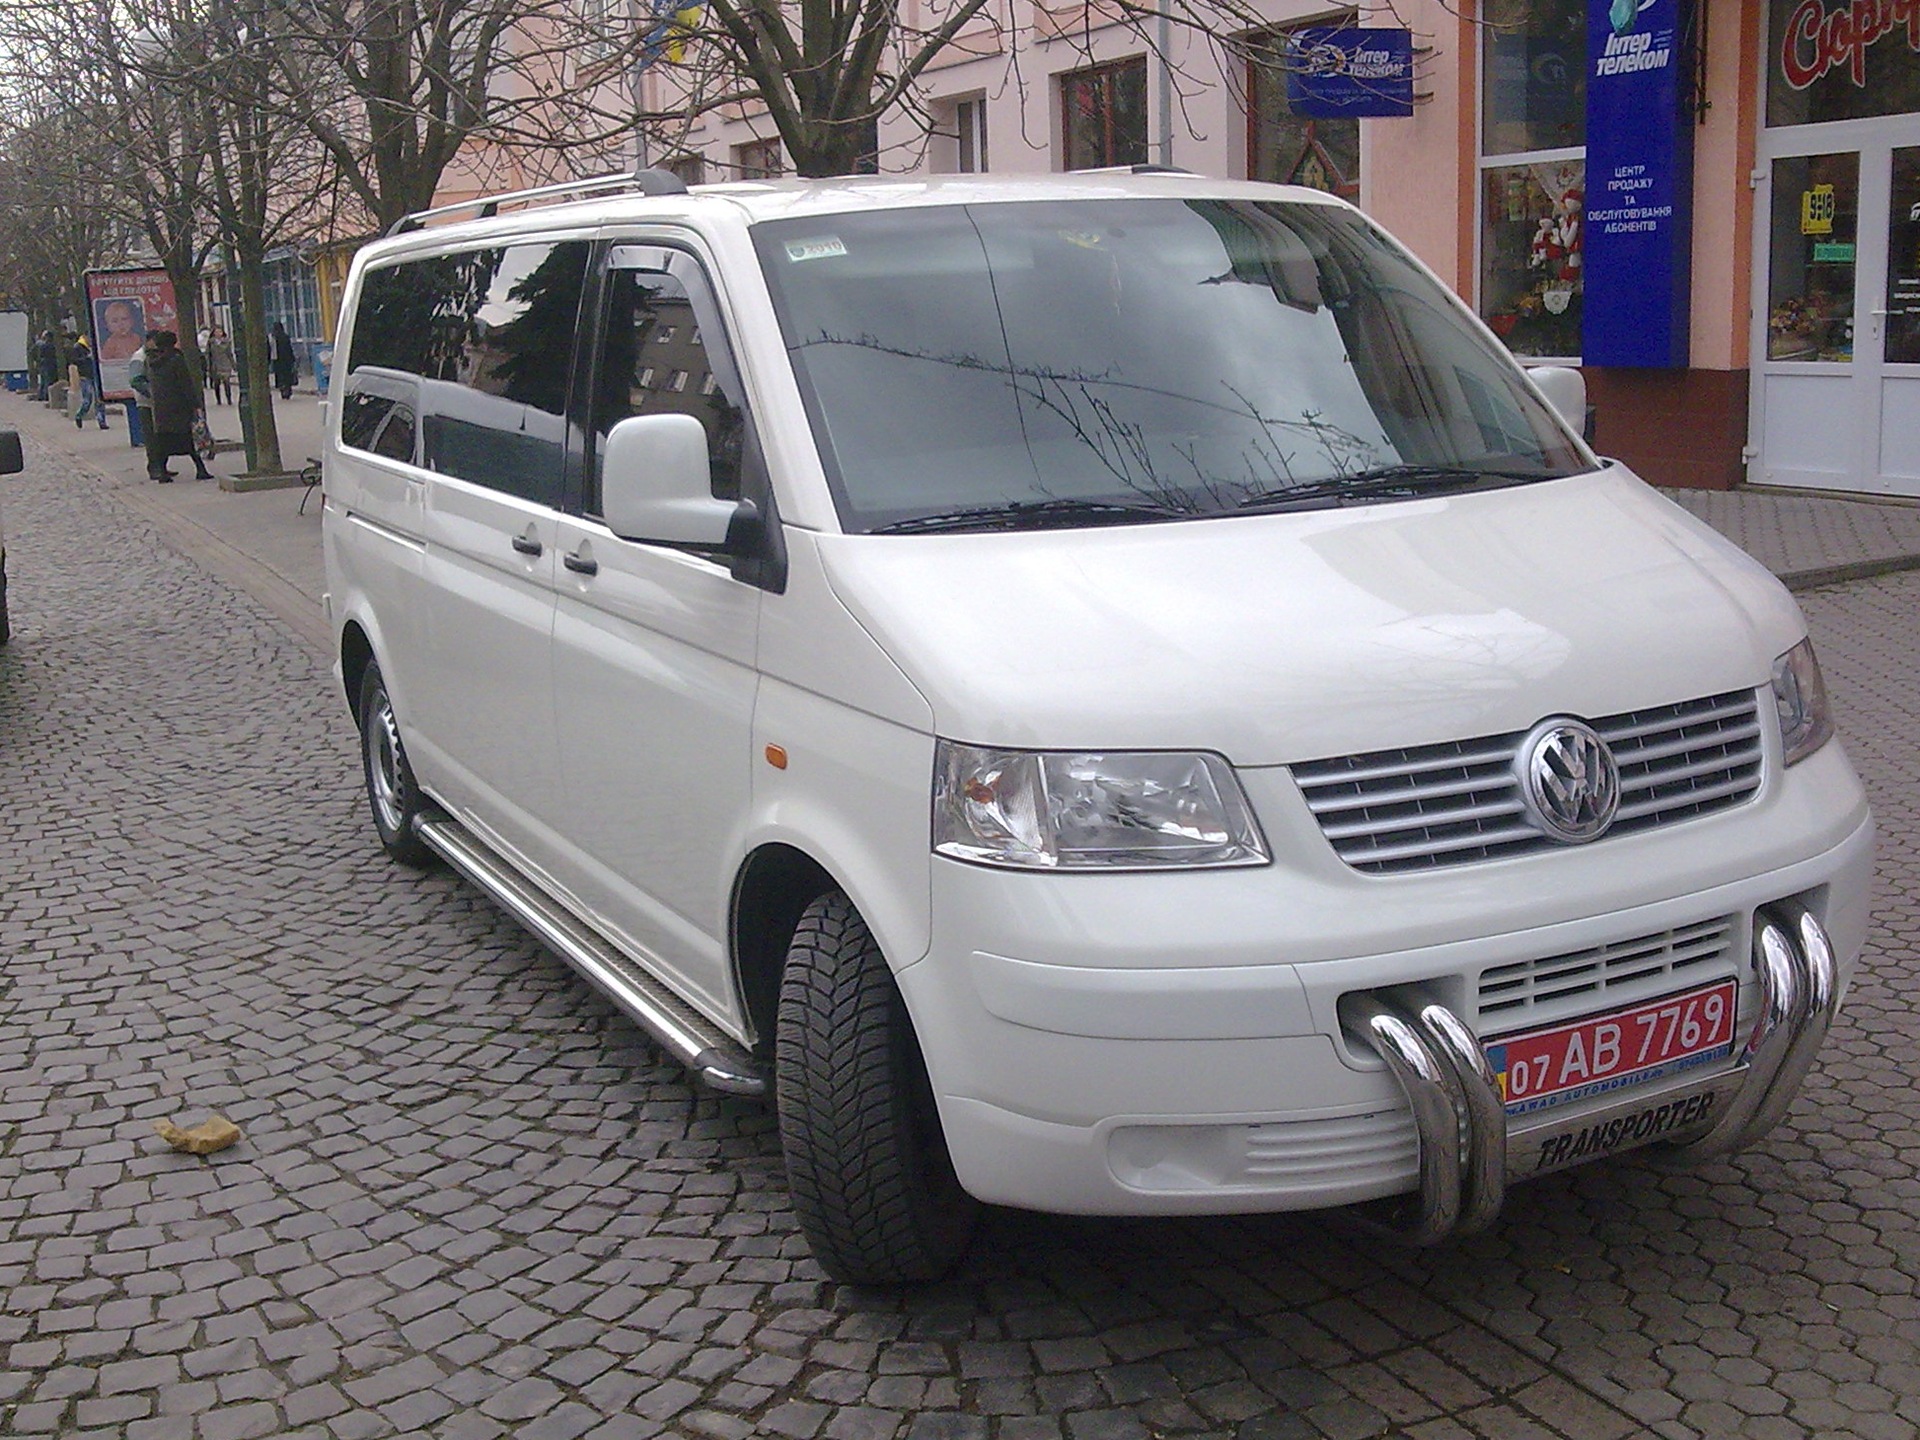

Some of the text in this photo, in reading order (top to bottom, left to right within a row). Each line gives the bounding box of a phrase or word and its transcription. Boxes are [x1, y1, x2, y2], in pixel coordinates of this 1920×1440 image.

[1604, 32, 1651, 57] Інтер
[1596, 49, 1670, 77] телеком
[1614, 165, 1646, 178] ЦЕНТР
[1608, 178, 1653, 191] ПРОДАЖУ
[1624, 195, 1636, 205] ТА
[1588, 206, 1672, 221] ОБСЛУГОВУВАННЯ
[1604, 221, 1657, 233] АБОНЕНТІВ
[1511, 1054, 1550, 1095] 07
[1559, 1023, 1621, 1084] AB
[1636, 994, 1723, 1063] 7769
[1535, 1091, 1715, 1170] TRANSPORTER
